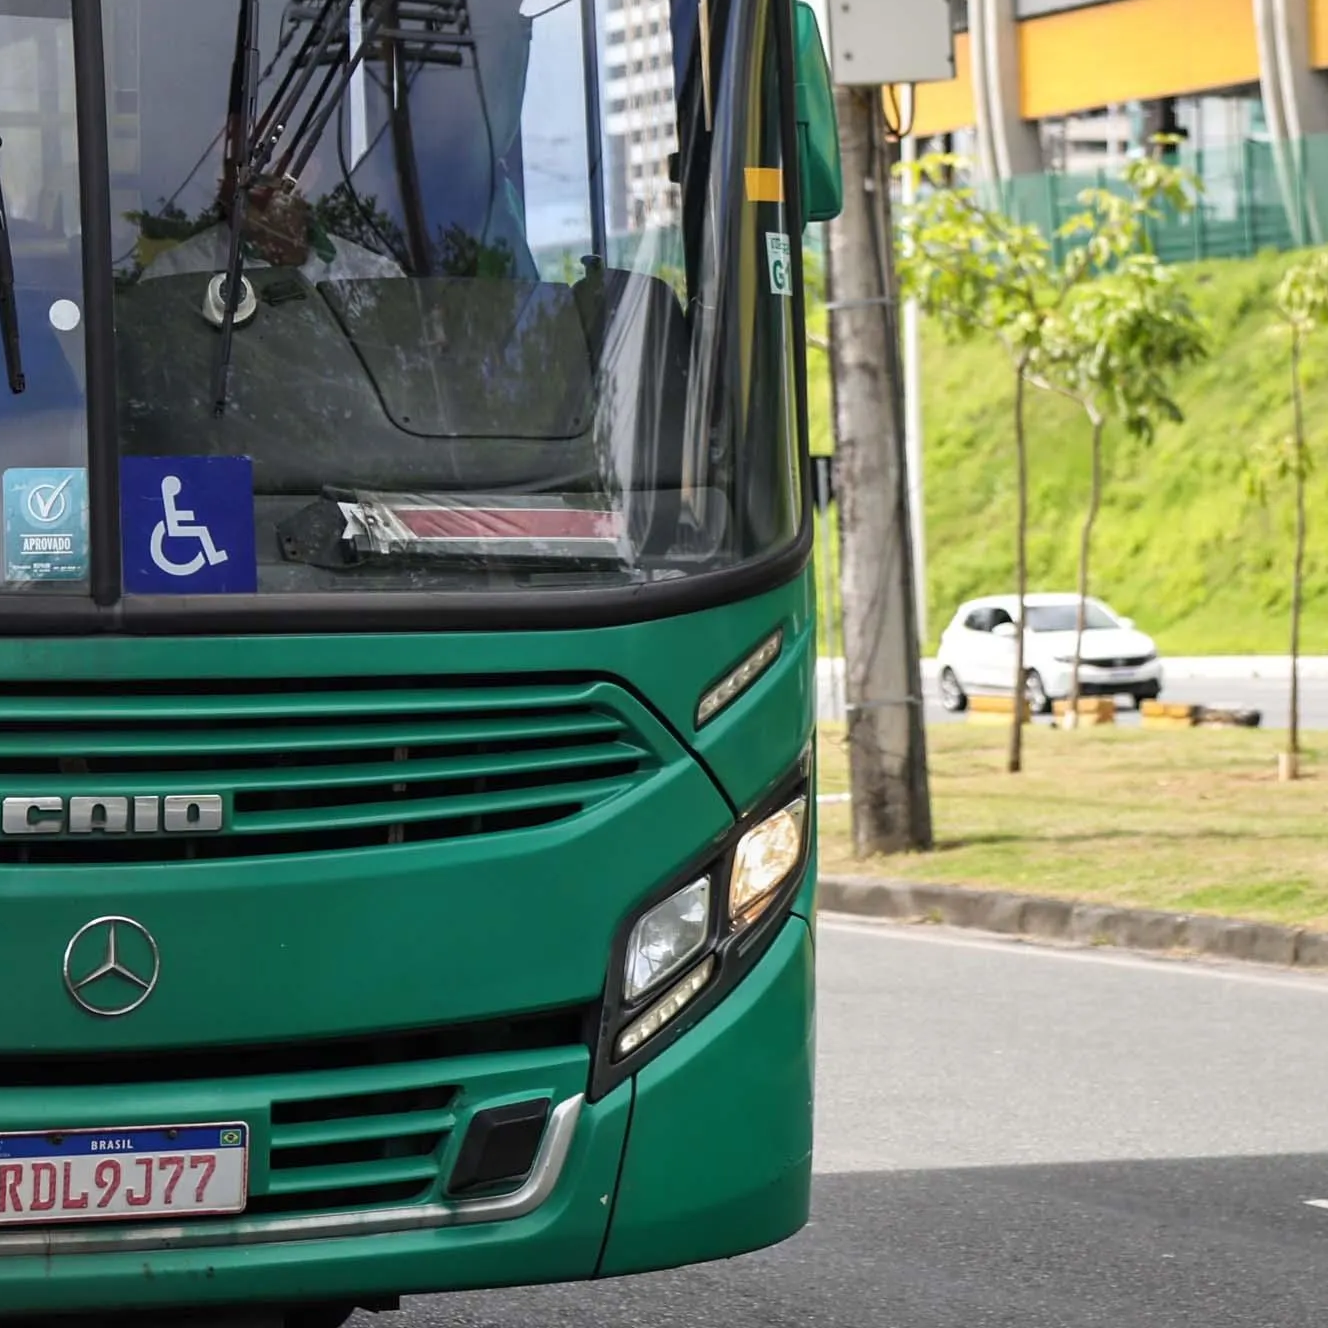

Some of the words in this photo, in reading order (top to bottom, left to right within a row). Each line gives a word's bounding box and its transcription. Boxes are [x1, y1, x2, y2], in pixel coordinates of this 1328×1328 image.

[23, 537, 71, 551] APROVADO
[2, 794, 222, 834] CAIO
[91, 1139, 134, 1151] BRASIL
